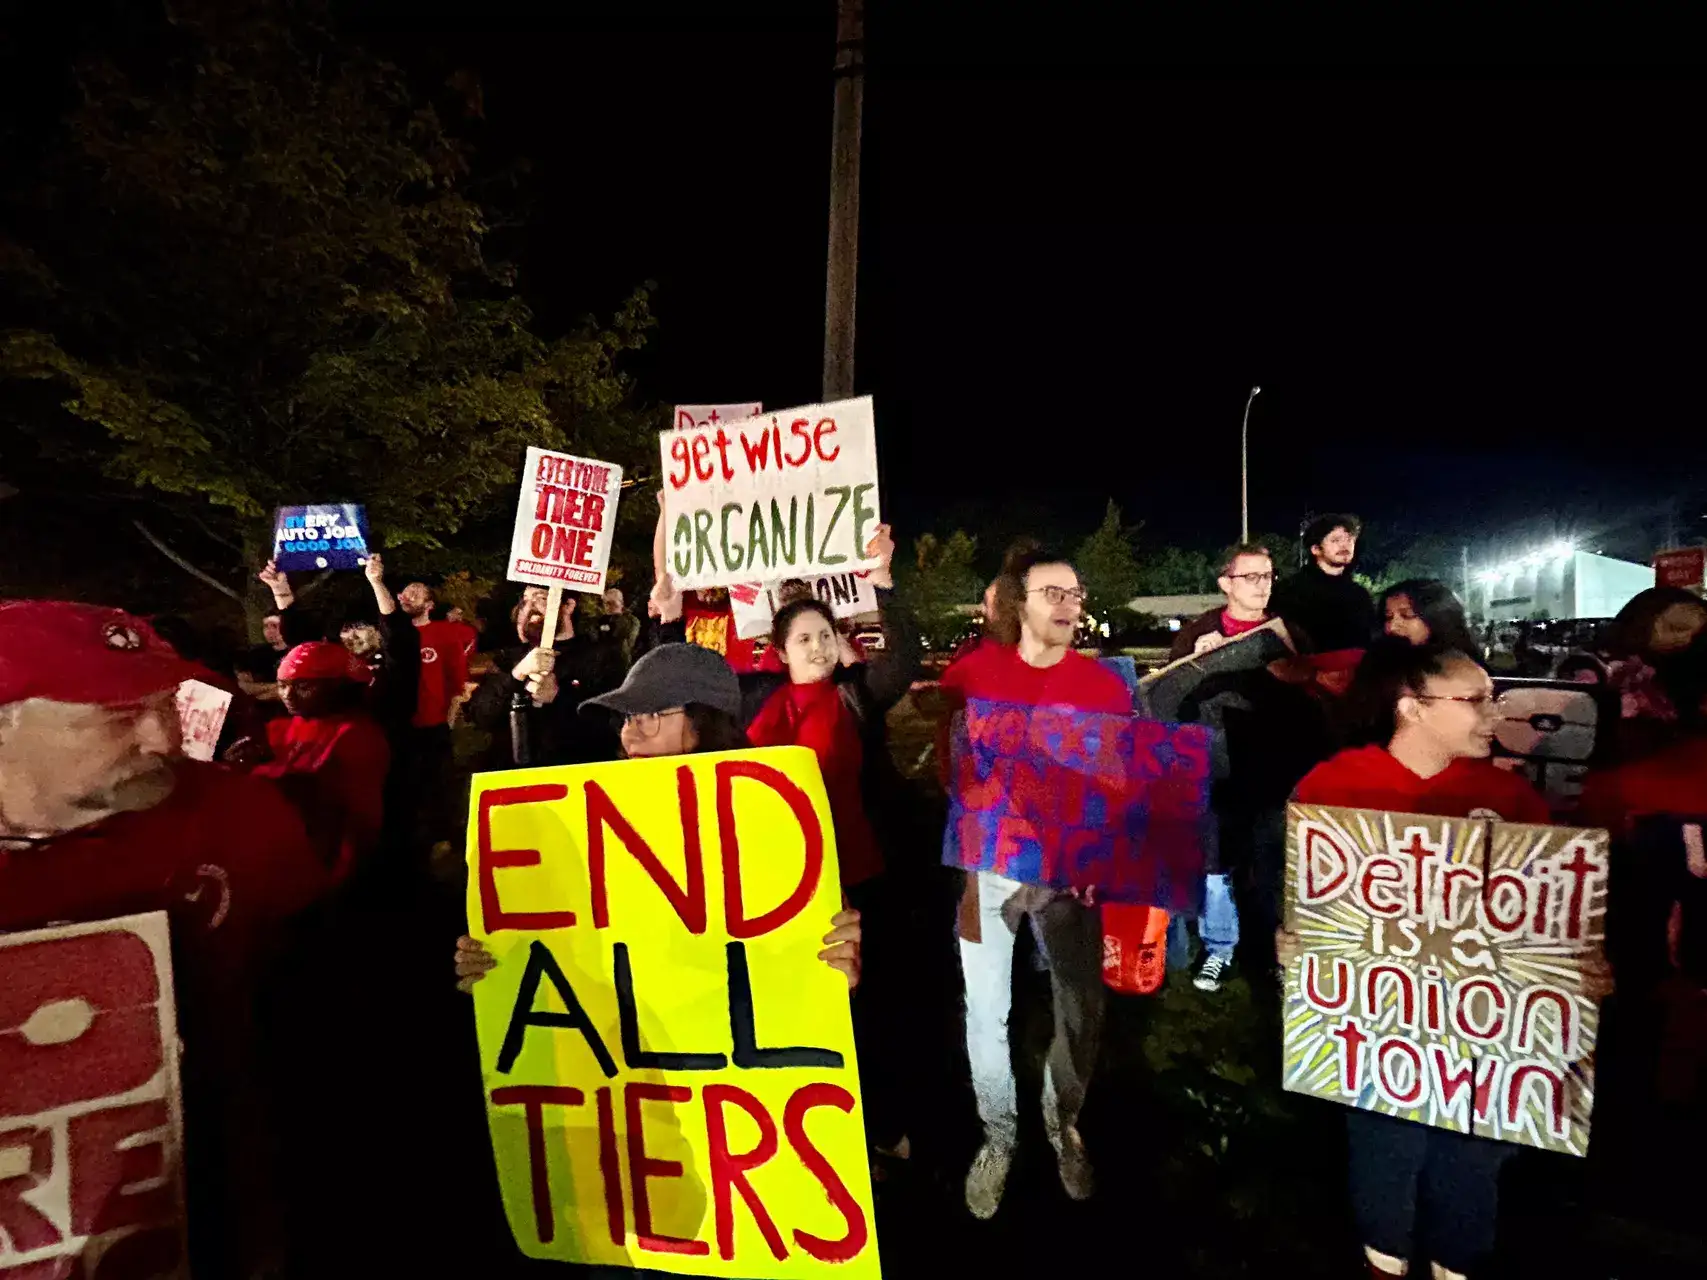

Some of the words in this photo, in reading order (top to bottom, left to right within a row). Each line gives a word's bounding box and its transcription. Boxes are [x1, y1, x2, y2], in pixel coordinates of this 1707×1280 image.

[536, 455, 612, 493] EVERYONE
[669, 428, 735, 490] get
[739, 415, 841, 472] wise
[276, 527, 319, 541] AUTO
[531, 524, 596, 568] ONE
[535, 483, 606, 532] TIER
[673, 483, 875, 577] ORGANIZE
[564, 566, 601, 584] FOREVER
[967, 709, 1210, 780] WORKERS
[478, 759, 824, 939] END
[1299, 820, 1600, 942] Detroit
[496, 940, 845, 1078] ALL
[1301, 953, 1579, 1061] union
[1327, 1016, 1571, 1138] town
[491, 1082, 868, 1264] TIERS
